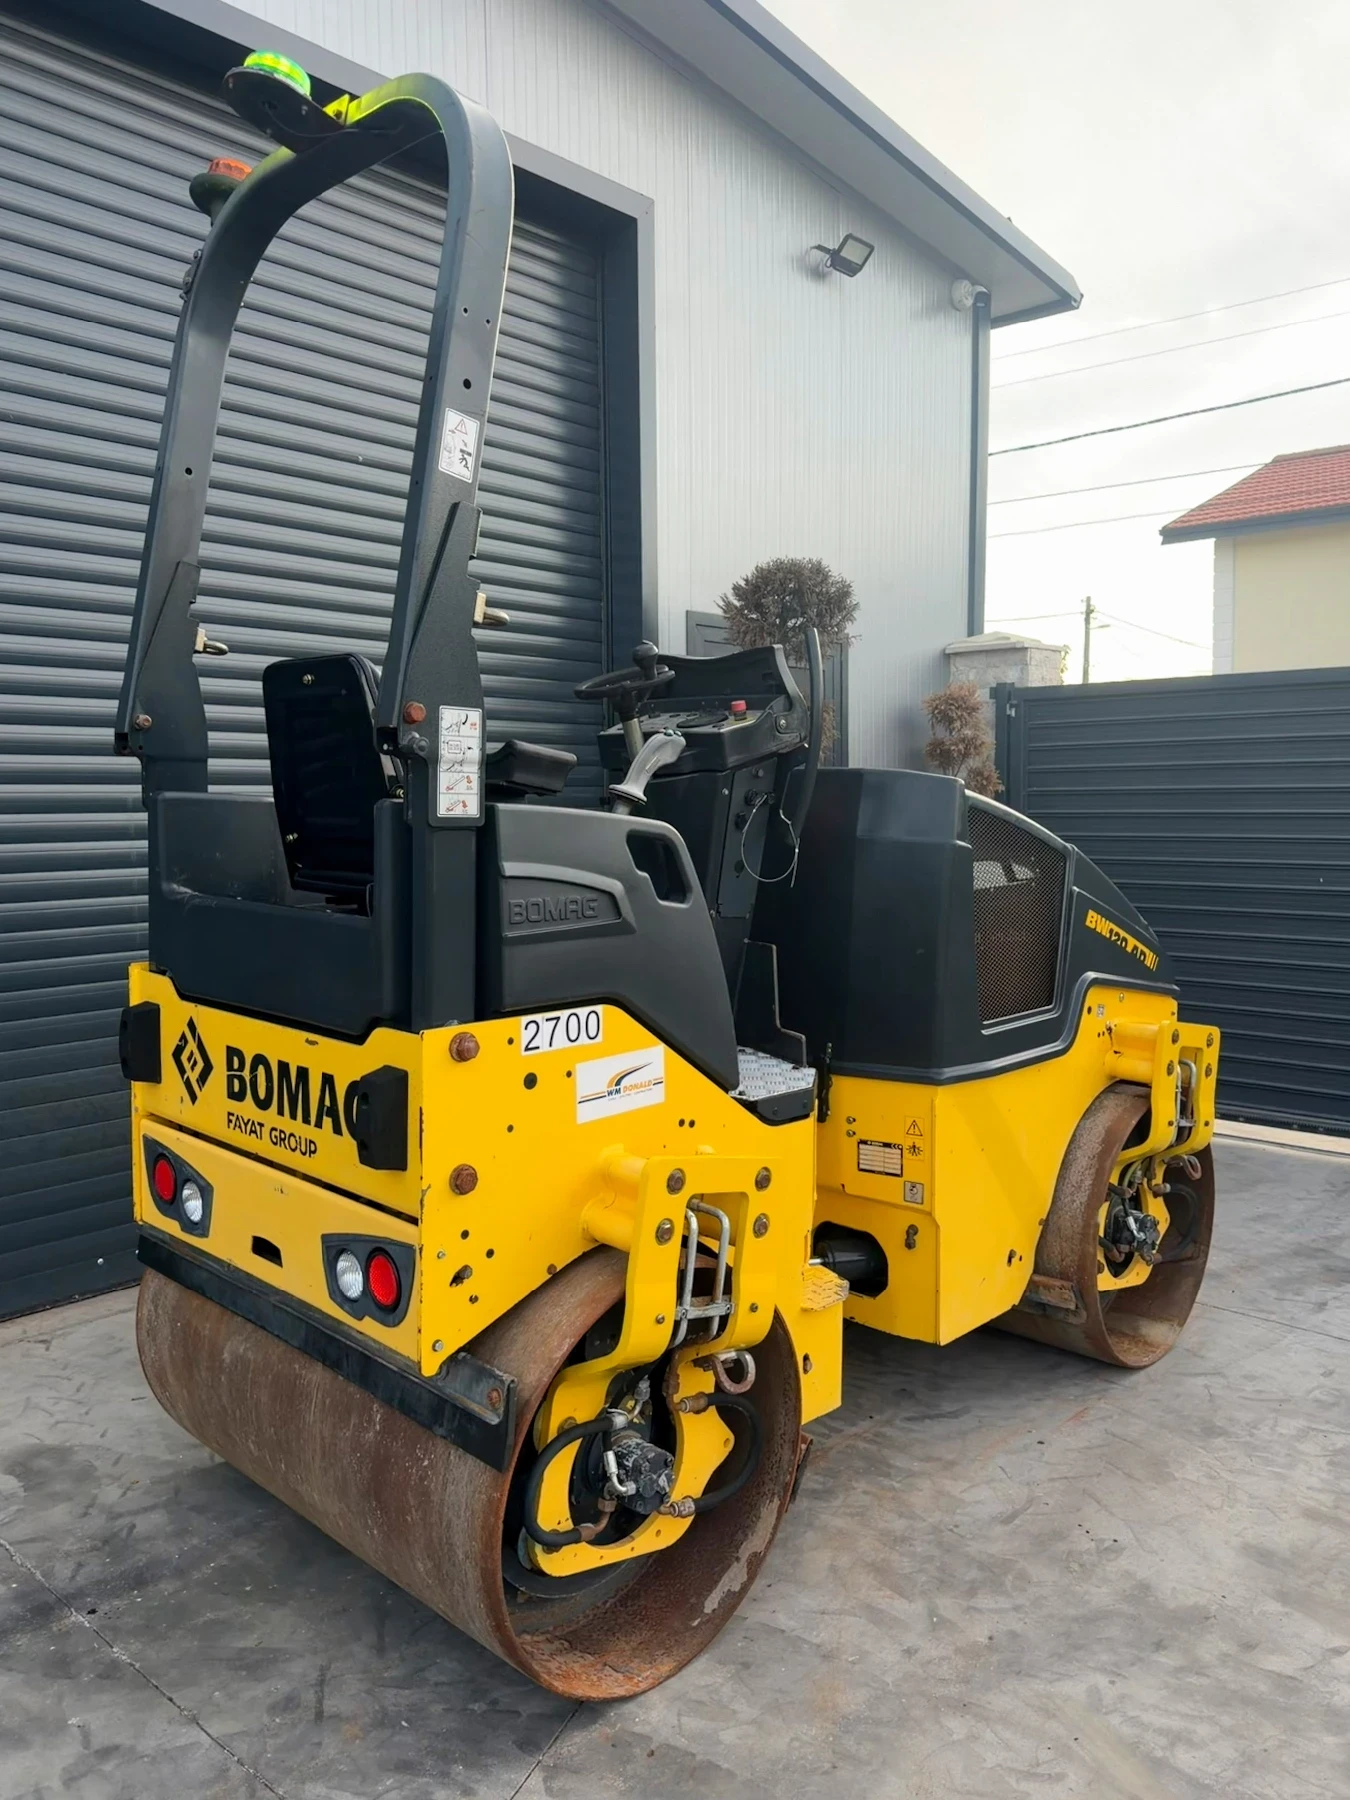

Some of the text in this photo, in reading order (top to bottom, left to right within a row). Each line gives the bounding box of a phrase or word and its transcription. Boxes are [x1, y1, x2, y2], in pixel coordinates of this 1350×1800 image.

[508, 897, 599, 925] BOMAG
[1085, 909, 1129, 950] BW120
[523, 1010, 601, 1053] 2700
[606, 1087, 622, 1097] WM
[622, 1080, 653, 1093] DONALD
[226, 1112, 318, 1159] FAYAT GROUP
